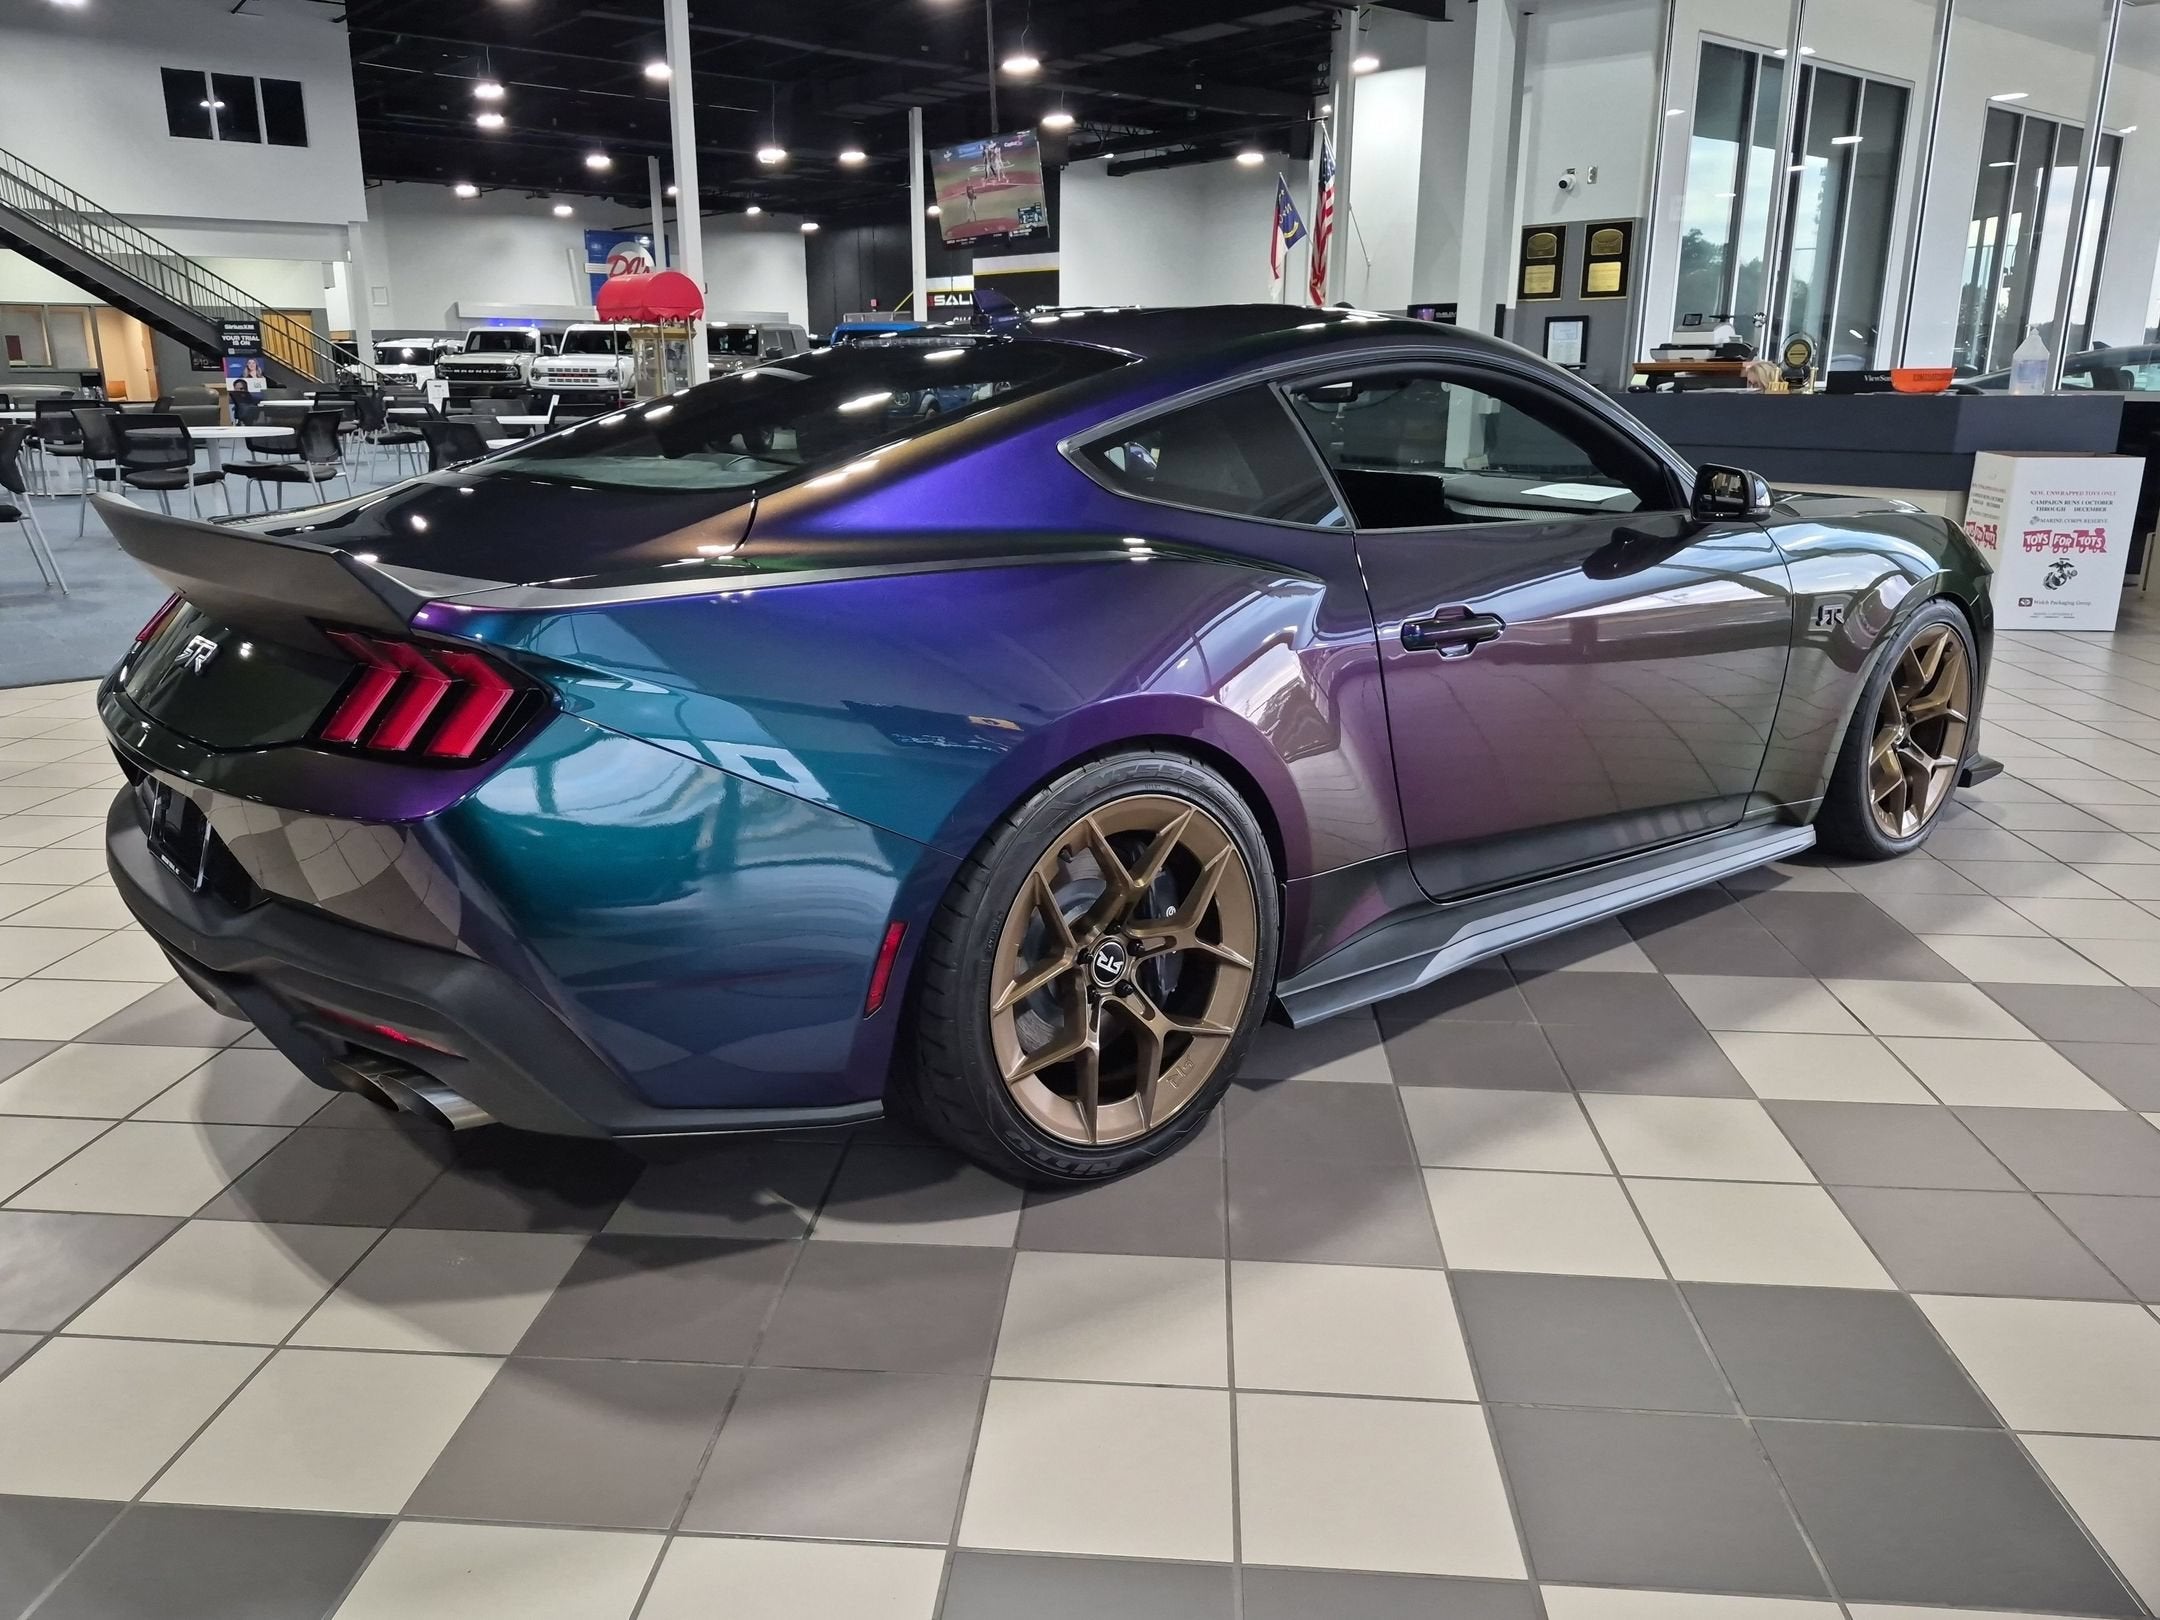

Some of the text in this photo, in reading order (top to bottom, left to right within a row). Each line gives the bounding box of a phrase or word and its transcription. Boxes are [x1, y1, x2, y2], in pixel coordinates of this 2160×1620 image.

[2025, 533, 2103, 548] TOYS FOR TOTS
